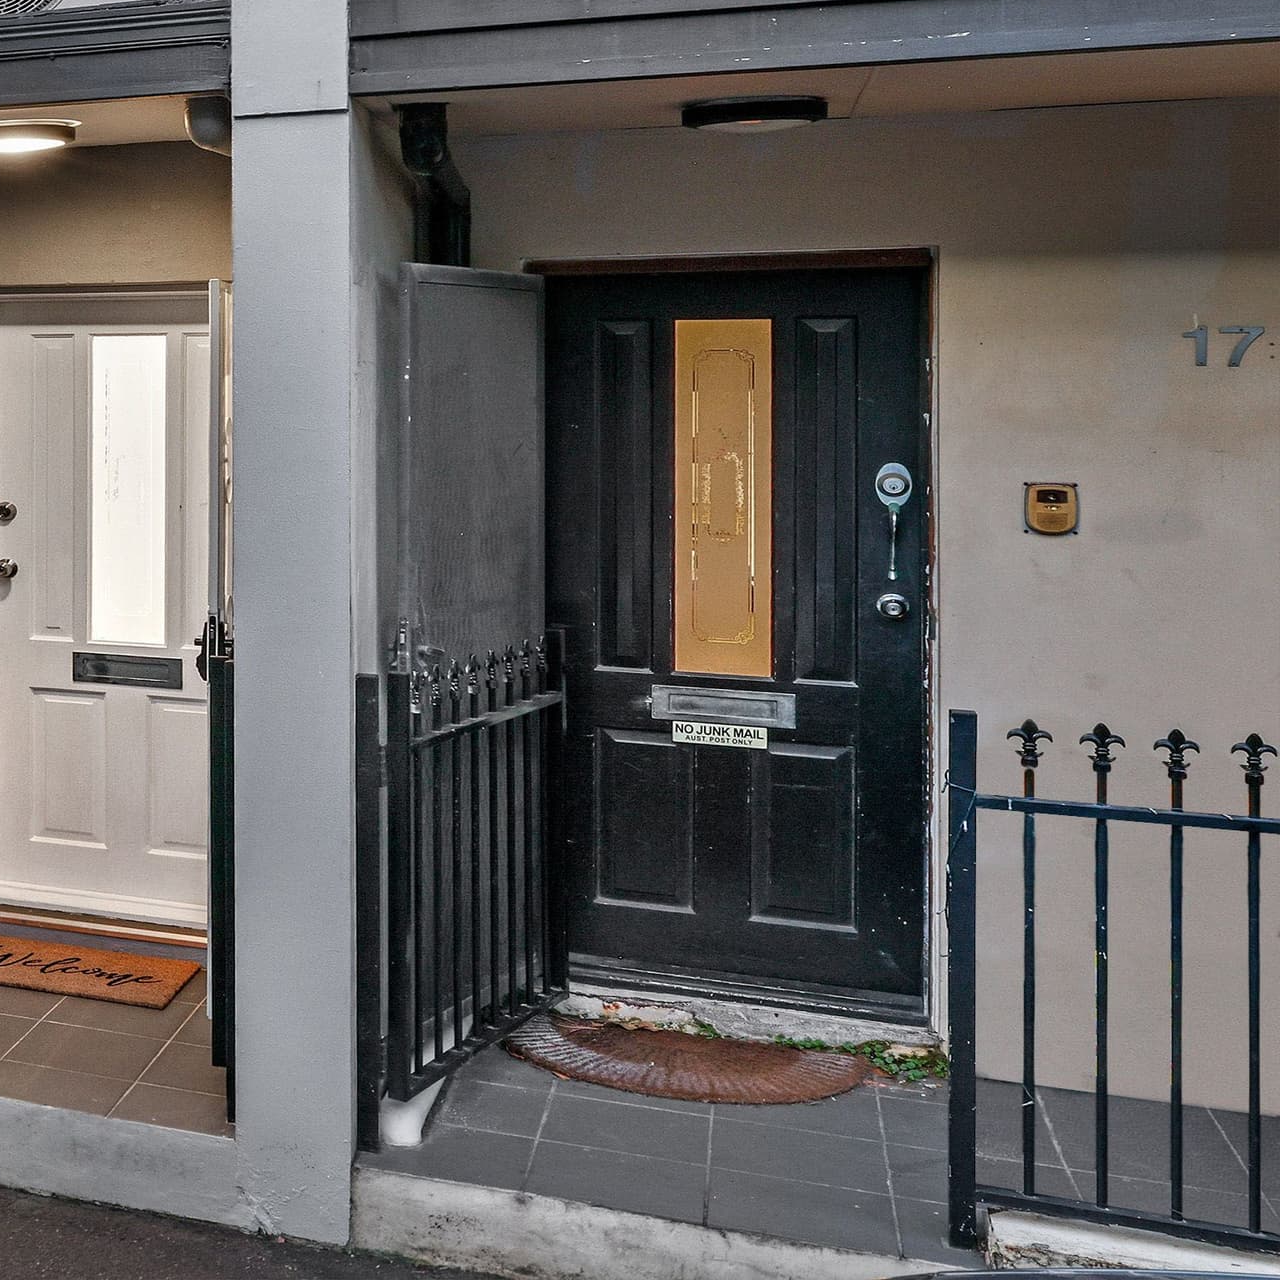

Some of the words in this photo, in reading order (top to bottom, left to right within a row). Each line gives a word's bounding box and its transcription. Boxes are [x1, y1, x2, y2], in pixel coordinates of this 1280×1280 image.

[1182, 325, 1265, 368] 17
[675, 723, 694, 734] NO
[696, 725, 731, 737] JUNK
[733, 728, 764, 740] MAIL
